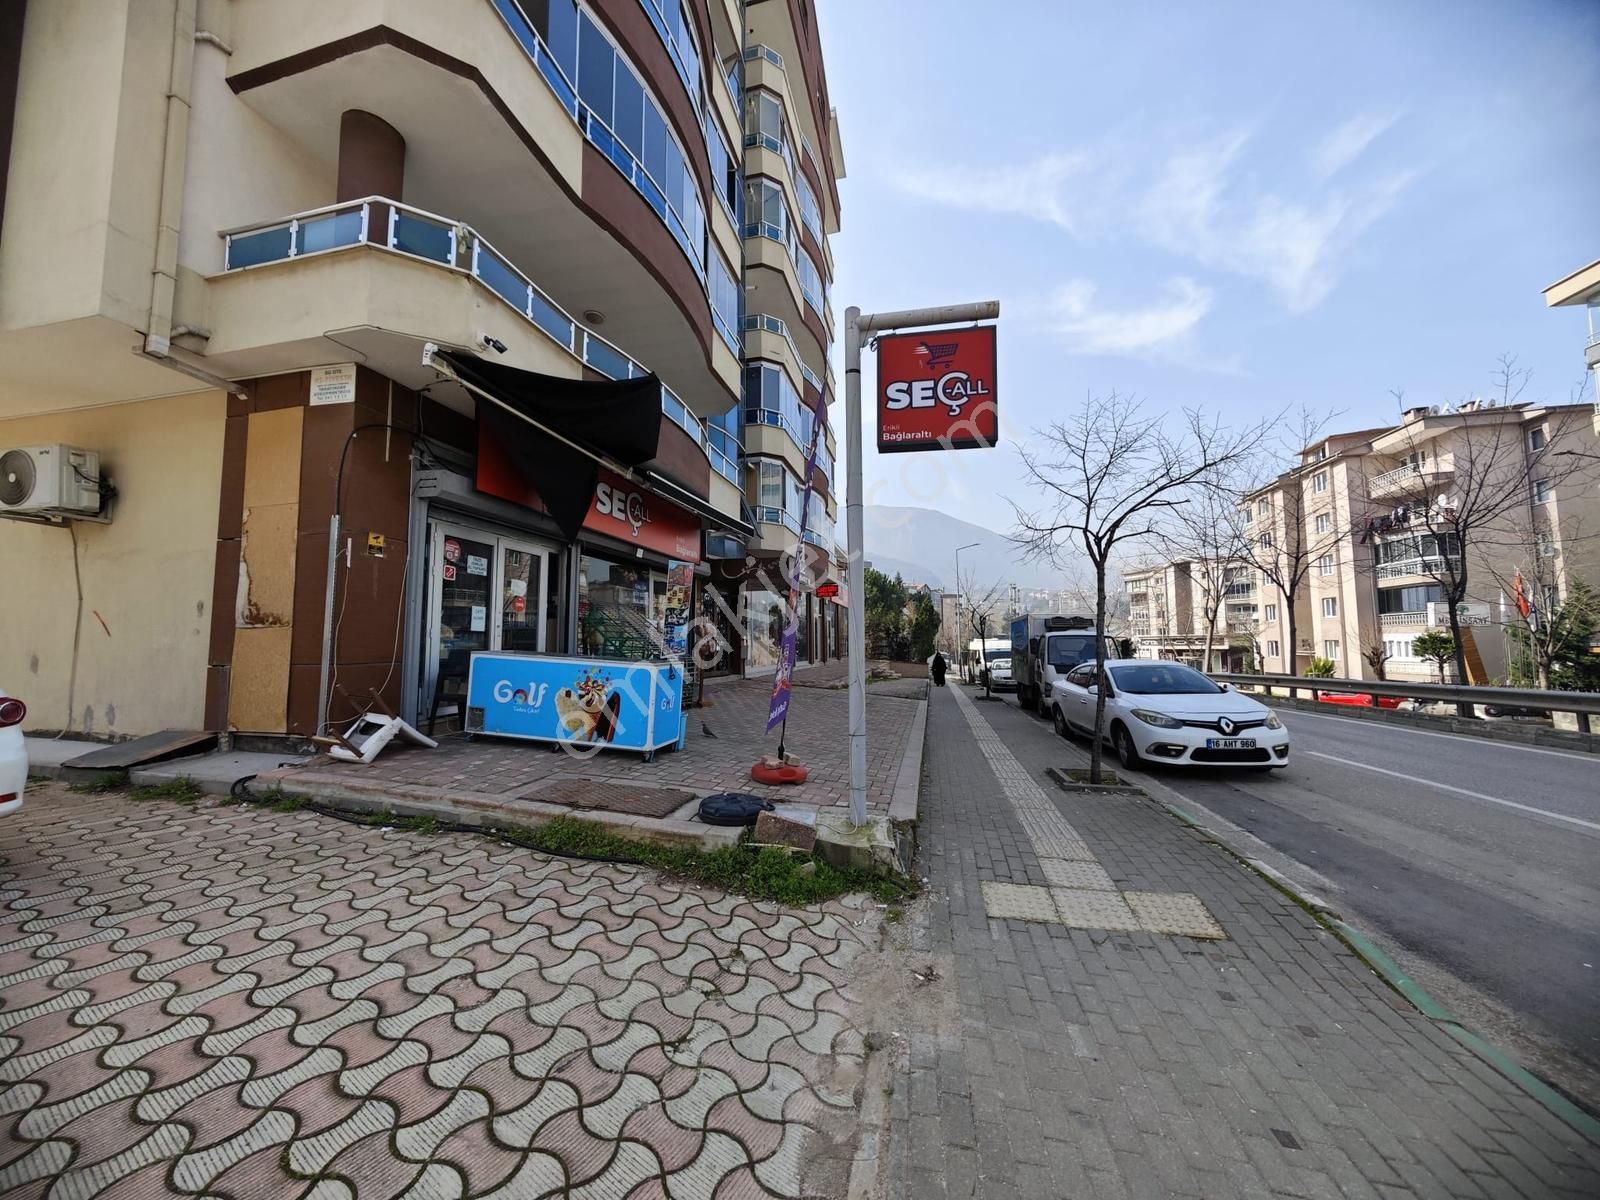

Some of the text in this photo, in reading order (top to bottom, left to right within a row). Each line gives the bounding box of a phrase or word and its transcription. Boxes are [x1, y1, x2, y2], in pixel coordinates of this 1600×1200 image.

[883, 430, 932, 441] Bağlaraltı
[493, 679, 549, 708] Golf
[1212, 739, 1255, 748] 16 AHT 960
